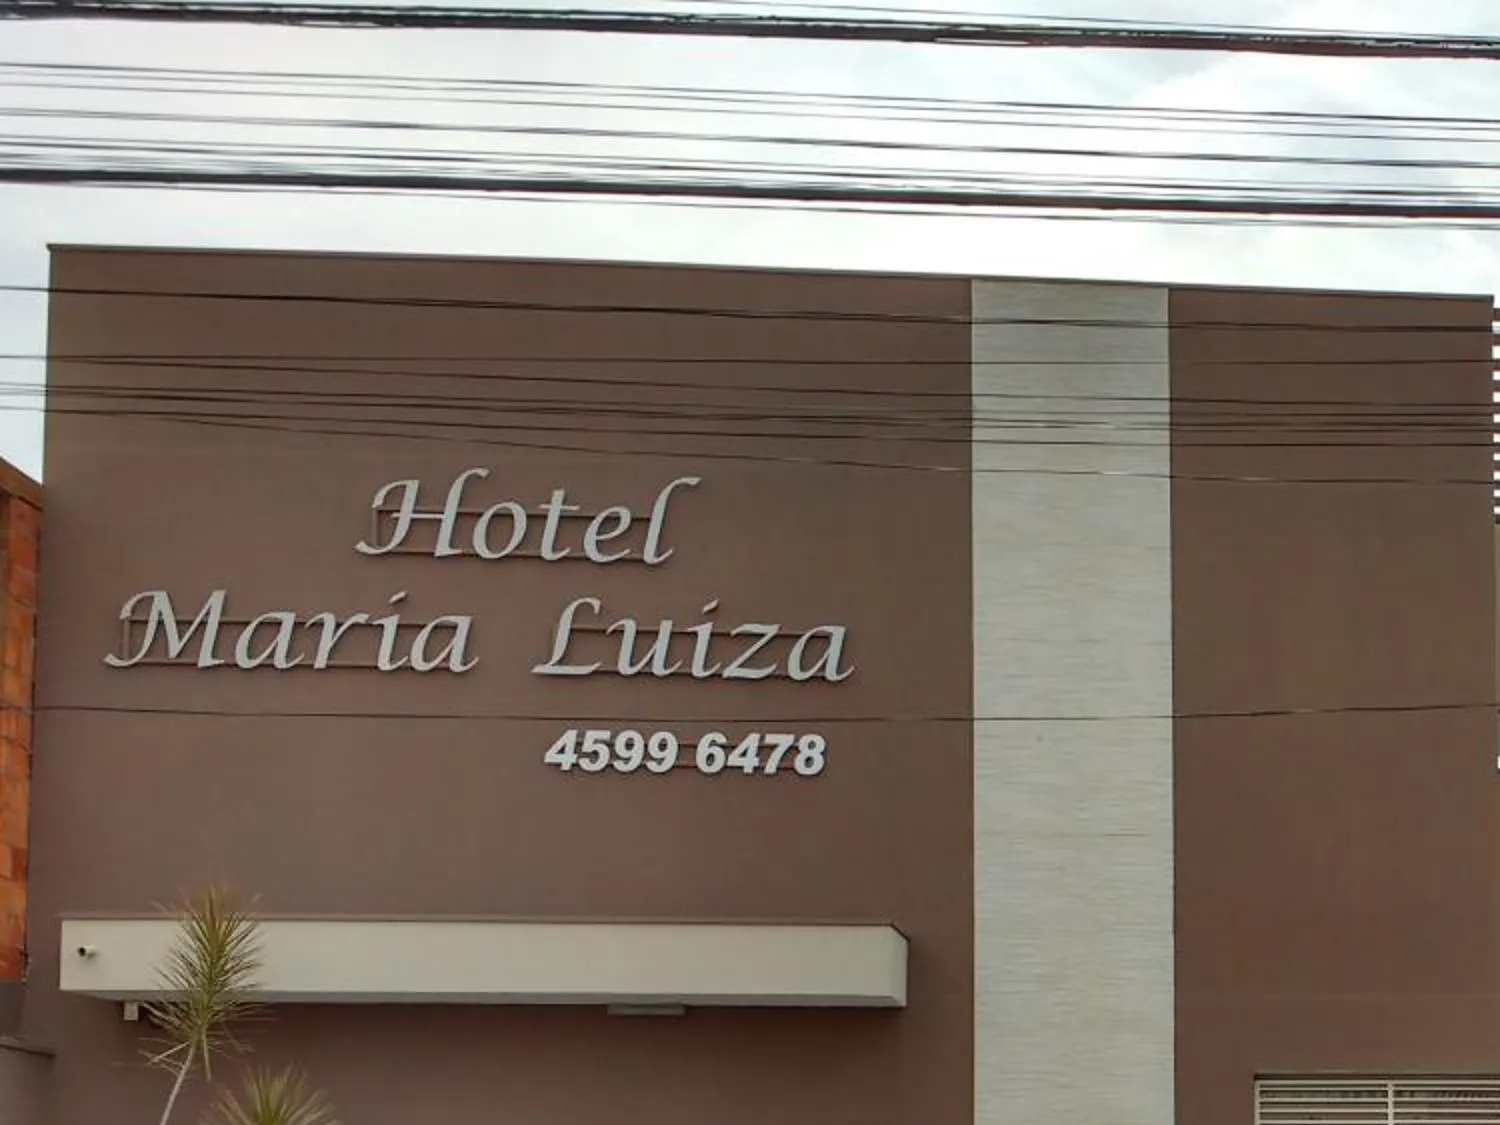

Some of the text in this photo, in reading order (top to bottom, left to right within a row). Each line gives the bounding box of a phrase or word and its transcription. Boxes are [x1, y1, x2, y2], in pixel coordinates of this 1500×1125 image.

[354, 467, 702, 565] Hotel
[103, 589, 855, 682] Maria Luiza
[543, 729, 827, 775] 4599 6478
